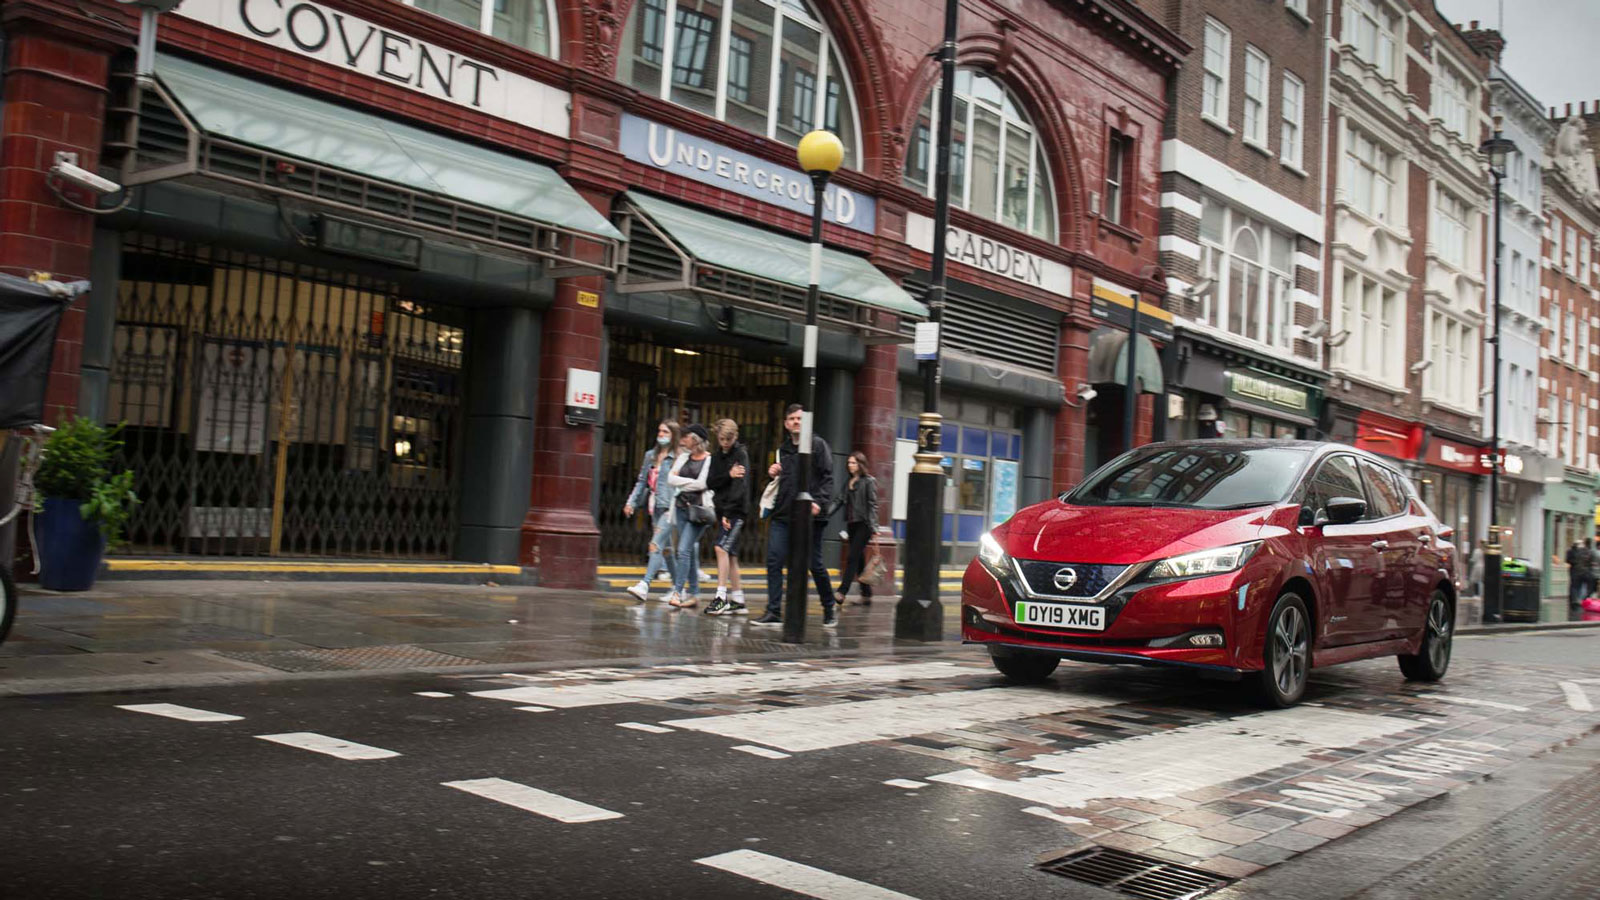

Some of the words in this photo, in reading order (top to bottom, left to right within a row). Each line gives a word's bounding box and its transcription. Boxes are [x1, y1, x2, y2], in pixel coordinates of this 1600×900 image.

[240, 0, 499, 107] COVENT
[944, 227, 1043, 285] GARDEN
[573, 391, 596, 405] LFB
[1029, 605, 1063, 623] OY19
[1068, 608, 1099, 626] XMG
[1251, 774, 1414, 819] LOOK
